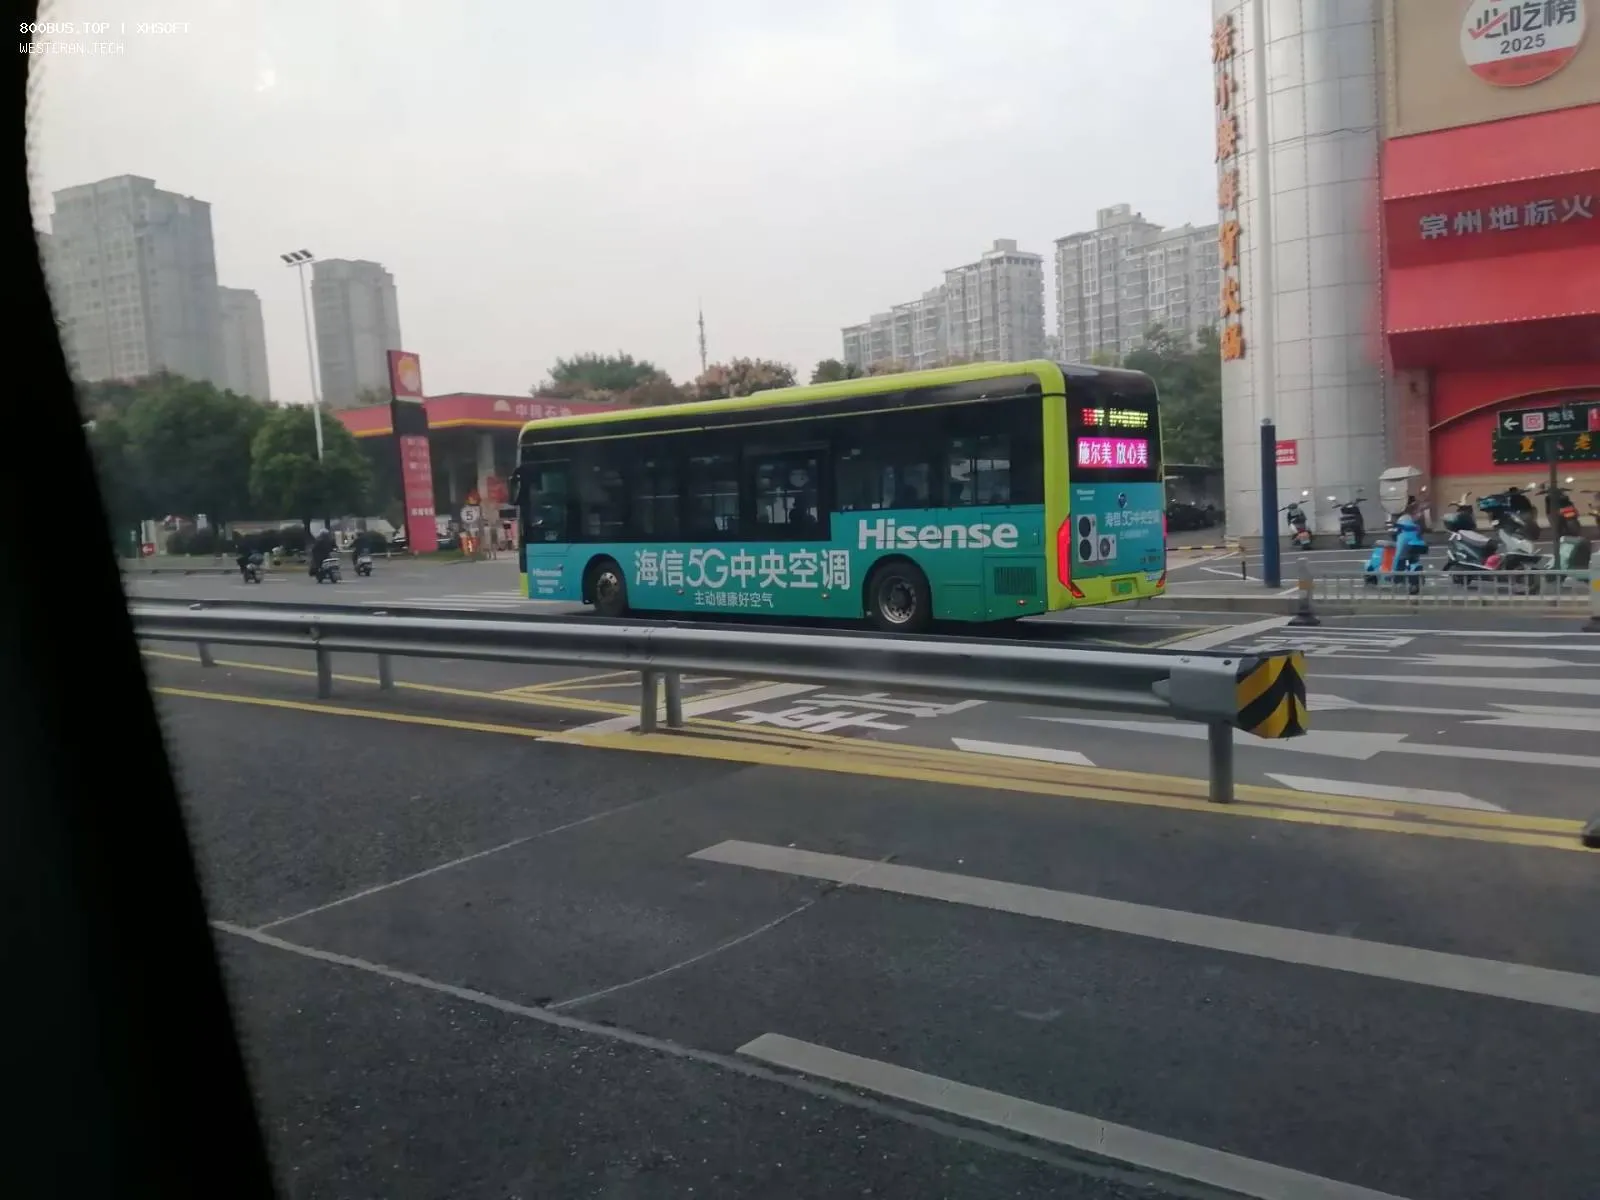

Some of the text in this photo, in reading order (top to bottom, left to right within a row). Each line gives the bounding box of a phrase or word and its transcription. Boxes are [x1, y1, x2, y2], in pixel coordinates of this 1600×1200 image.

[1468, 0, 1577, 39] 必吃榜
[1500, 33, 1546, 54] 2025
[1419, 194, 1594, 240] 常州地标火
[1116, 442, 1148, 464] 放心美
[858, 518, 1019, 550] Hisense
[634, 548, 851, 590] 海信5G中央空调
[695, 590, 774, 608] 主动健康好空气
